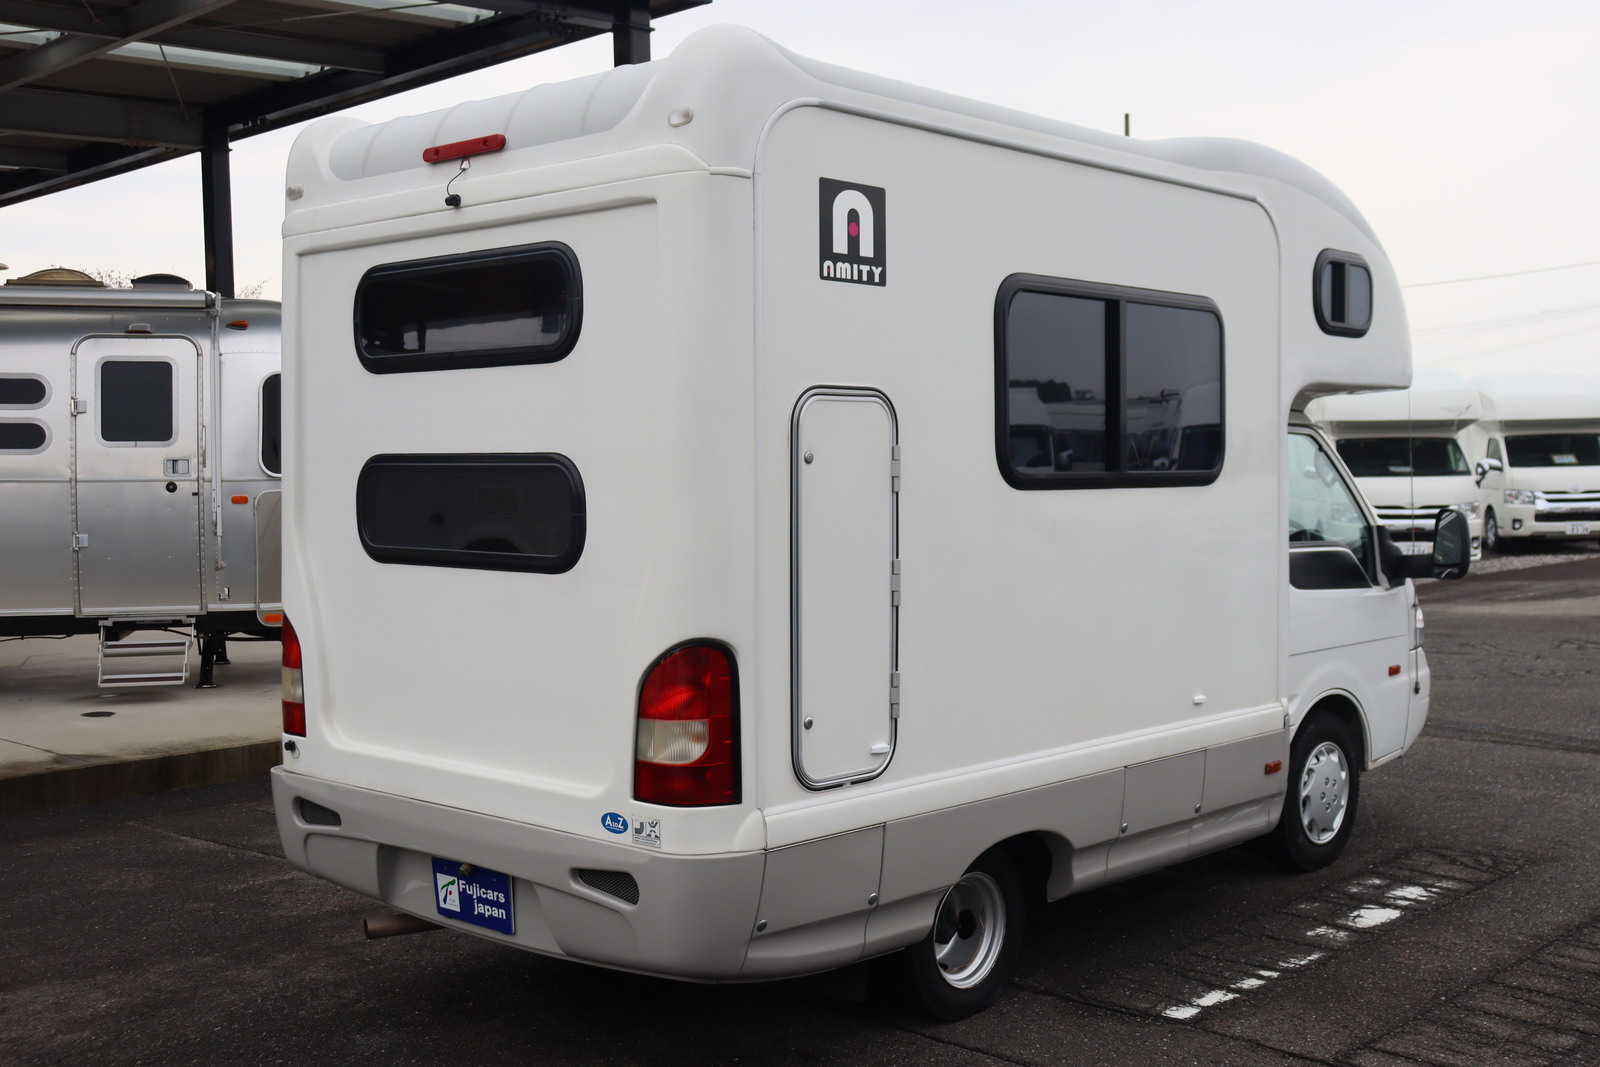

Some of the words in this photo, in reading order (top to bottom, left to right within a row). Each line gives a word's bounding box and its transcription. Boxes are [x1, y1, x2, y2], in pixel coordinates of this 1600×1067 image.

[823, 260, 883, 283] AMITY
[459, 880, 506, 903] Fujicars
[474, 900, 506, 919] japan
